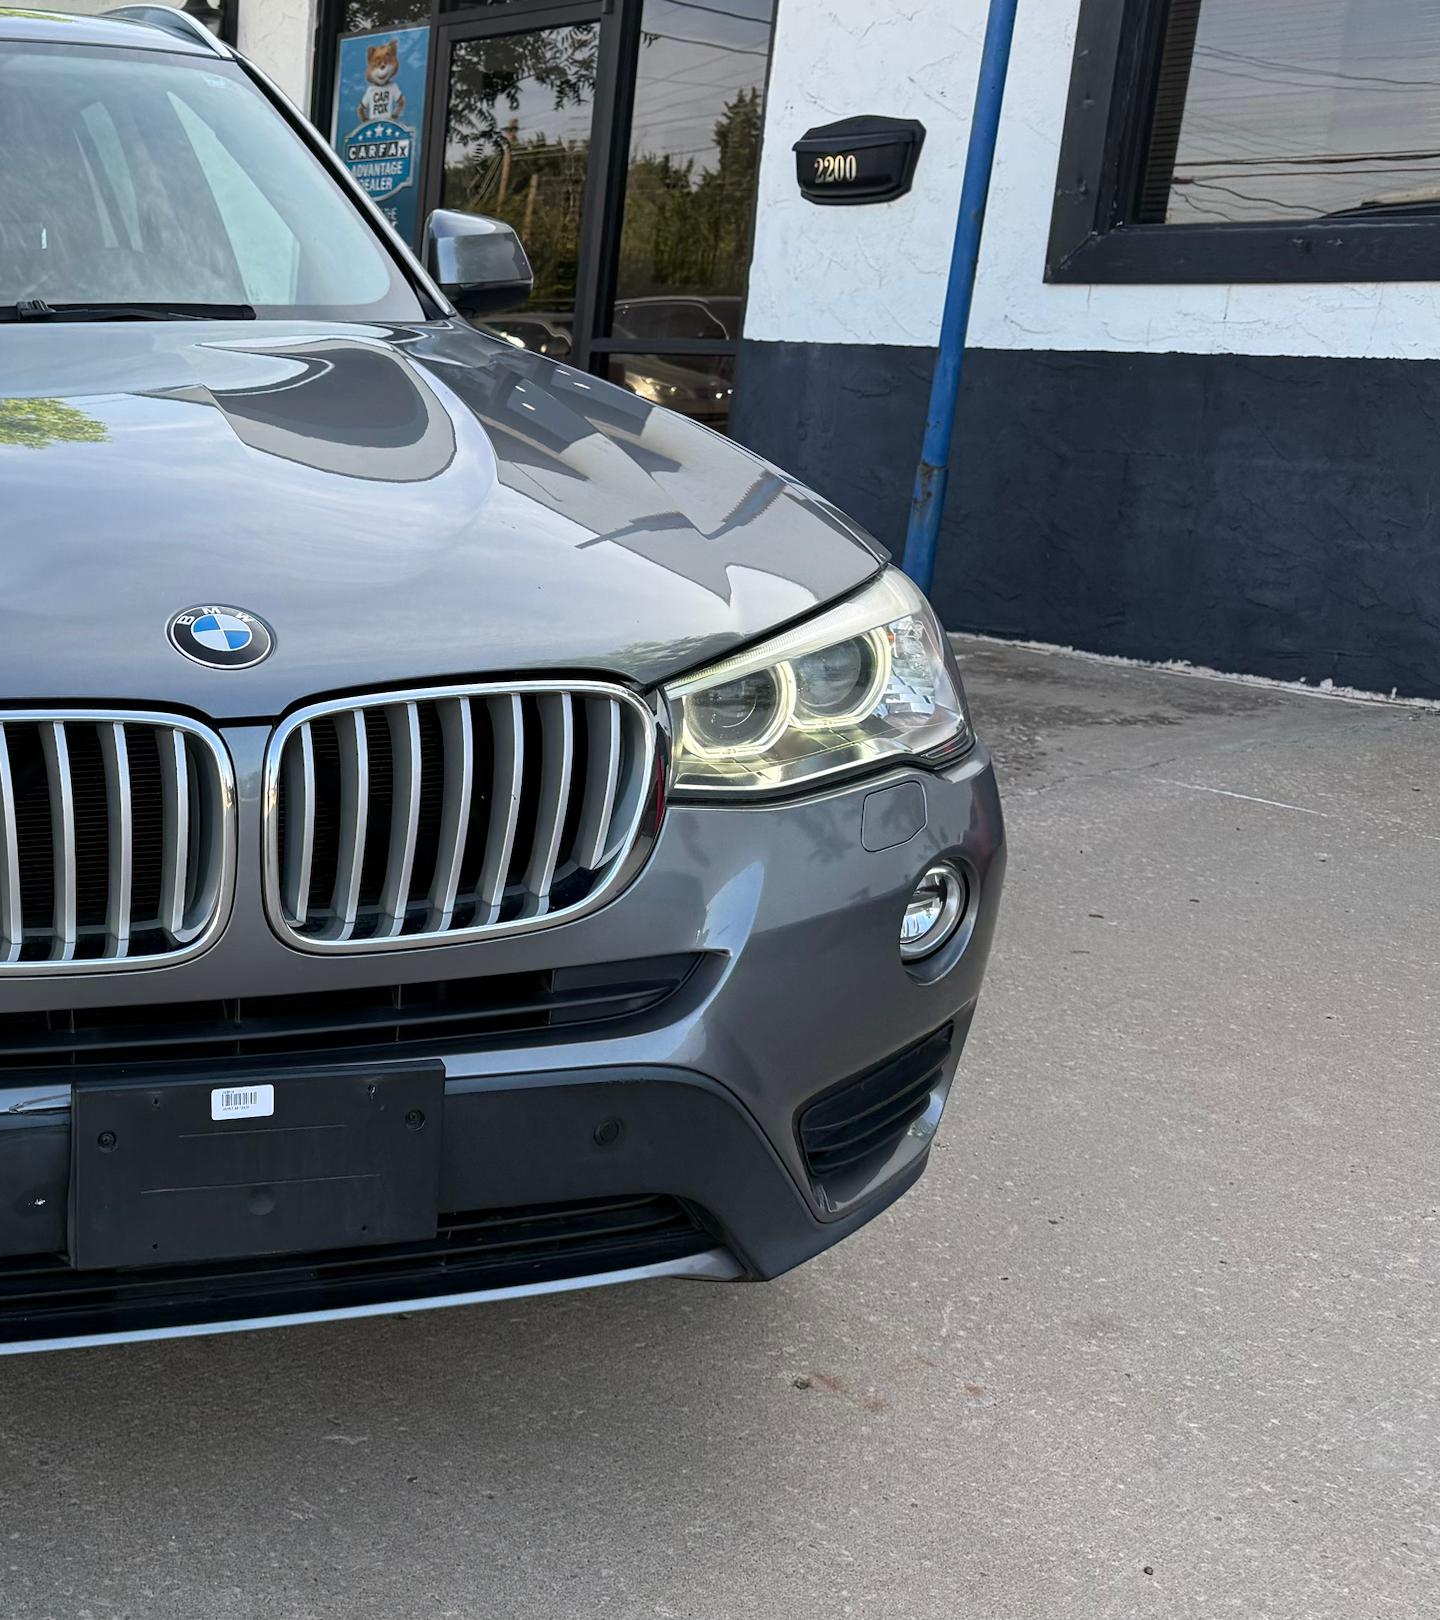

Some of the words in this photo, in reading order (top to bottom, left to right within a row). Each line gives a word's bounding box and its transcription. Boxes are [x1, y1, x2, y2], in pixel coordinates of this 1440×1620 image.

[373, 91, 390, 103] CAR
[373, 103, 389, 115] FOX
[348, 143, 407, 159] CARFAX
[351, 161, 402, 177] ADVANTAGE
[814, 155, 856, 183] 2200
[177, 607, 253, 625] BMW
